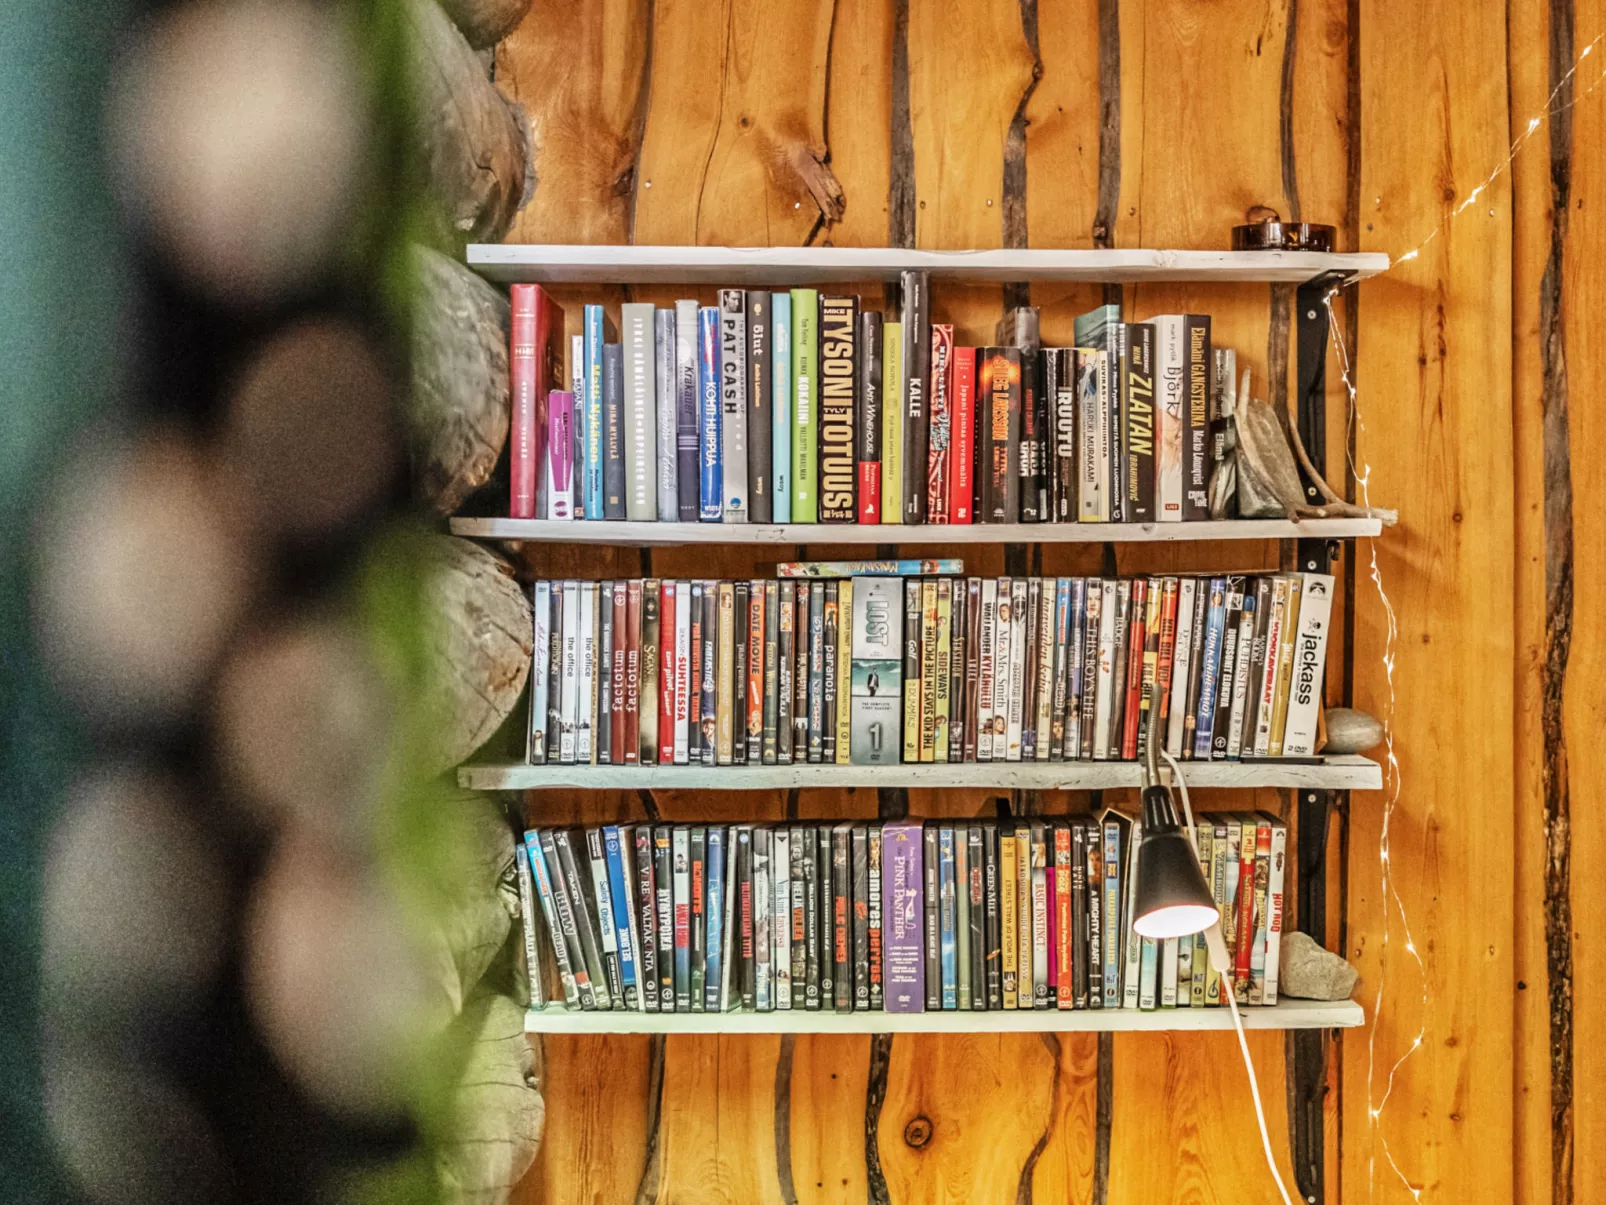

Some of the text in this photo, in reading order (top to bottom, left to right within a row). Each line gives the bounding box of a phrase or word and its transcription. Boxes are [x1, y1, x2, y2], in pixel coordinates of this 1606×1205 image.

[633, 318, 643, 348] JYRKI
[823, 309, 853, 396] TYSON
[1169, 343, 1177, 362] pytlik
[1191, 327, 1206, 363] Elämäni
[590, 364, 601, 400] Matti
[634, 352, 645, 419] HÄMÄLÄINEN
[684, 366, 695, 415] Krakauer
[724, 320, 736, 414] PAT CASH
[1164, 367, 1181, 411] björk
[608, 404, 617, 424] MIKA
[705, 382, 716, 415] KOHTI
[798, 376, 809, 424] KOKAIINI
[866, 383, 876, 454] AMY WINEHOUSE
[910, 378, 921, 417] KALLE
[992, 359, 1009, 441] STIEG LARSSON
[1191, 364, 1206, 427] GANGSTERINA
[588, 404, 601, 463] Nykänen
[609, 426, 619, 459] MYLLYLÄ
[705, 418, 716, 467] HUIPPUA
[959, 385, 969, 487] Japani pintaa syvemmältä
[1058, 392, 1072, 457] RUUTU
[1129, 346, 1152, 502] MINÄ ZLATAN IBRAHIMOVIĆ
[1193, 431, 1204, 452] Marko
[1215, 433, 1225, 460] Elämä
[823, 408, 853, 508] TOTUUS
[1191, 452, 1204, 485] Lönnqvist
[636, 485, 647, 505] KUU
[777, 475, 785, 493] wsoy
[752, 604, 760, 674] DATE MOVIE
[866, 601, 889, 646] LOST
[1115, 616, 1124, 648] BADGE
[1160, 618, 1174, 661] KILL BILL
[567, 637, 575, 677] the office
[644, 645, 656, 674] SAGAN
[705, 640, 713, 681] FANTASTIC
[825, 645, 836, 701] paranoia
[908, 640, 917, 660] Golf
[952, 636, 965, 677] SENSATION
[980, 602, 994, 709] WALLANDER KYLÄHULLU
[997, 630, 1008, 708] Mr. Mrs. Smith
[1083, 626, 1098, 720] THIS BOY'S LIFE
[1142, 663, 1153, 682] KILL
[1202, 627, 1217, 718] HOKKARIHEMMOT
[1220, 628, 1237, 708] DUUDSONIT ELOKUVA
[1237, 638, 1252, 699] PUHDISTUS
[1251, 637, 1260, 662] ROOM
[1298, 633, 1322, 705] jackass
[612, 650, 624, 711] factotum
[626, 650, 637, 712] factotum
[663, 668, 674, 691] pilvet
[677, 656, 687, 721] SUHTEESSA
[923, 626, 935, 749] THE KID STAYS IN THE PICTURE
[937, 651, 948, 699] SIDEWAYS
[869, 723, 883, 752] 1
[567, 871, 580, 905] TAKEN
[894, 855, 905, 939] PINK PANTHER
[987, 864, 996, 917] GREEN MILE
[1215, 852, 1225, 904] YEARBOOK
[555, 891, 575, 935] BLOW
[601, 908, 611, 935] Objects
[641, 866, 653, 971] VEREN VALTAKUNTA
[658, 888, 672, 951] HYMYPOIKA
[836, 896, 847, 963] PUBLIC ENEMIES
[868, 869, 881, 983] amores perros
[1006, 925, 1012, 933] OF
[1035, 883, 1046, 947] BASIC INSTINCT
[1091, 897, 1099, 934] MIGHTY
[1270, 893, 1283, 933] HOT ROD
[1091, 935, 1099, 965] HEART
